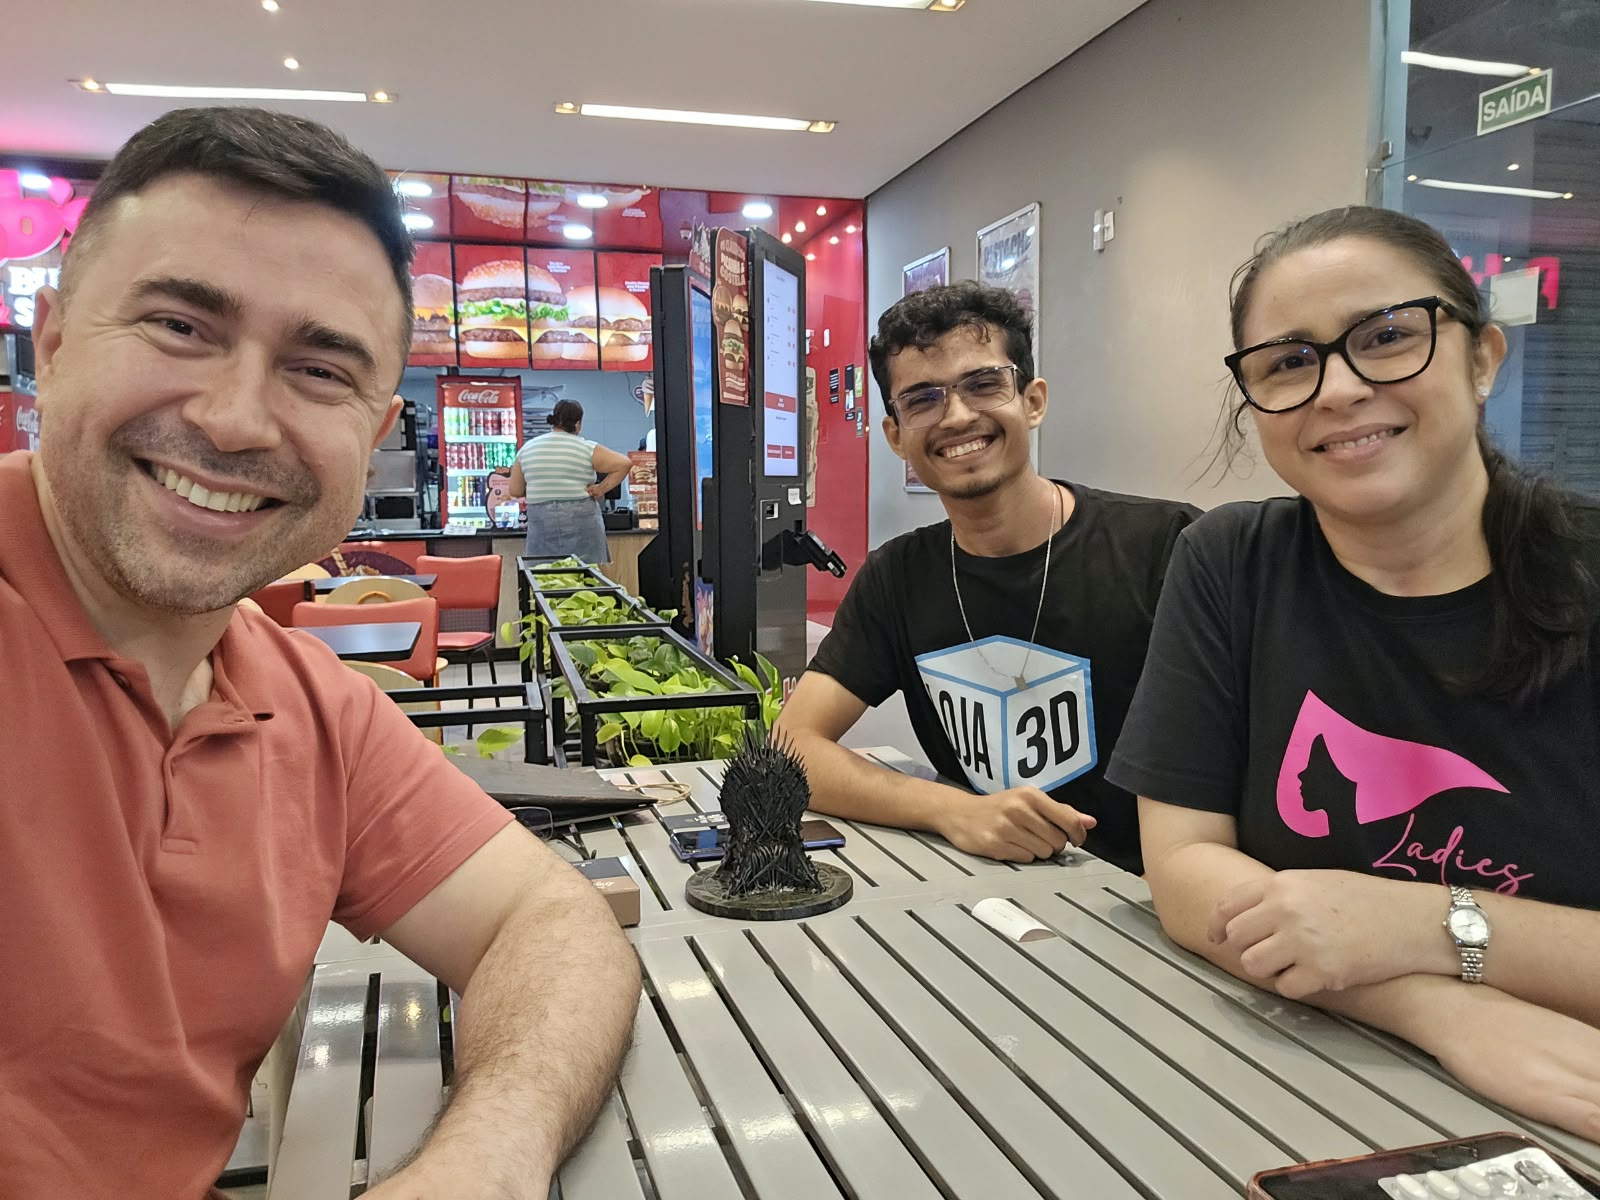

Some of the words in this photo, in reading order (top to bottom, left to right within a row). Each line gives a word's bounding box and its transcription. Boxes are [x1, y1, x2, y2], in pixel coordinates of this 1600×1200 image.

[1483, 85, 1545, 122] SAÍDA
[925, 683, 994, 781] OJA
[1015, 690, 1081, 779] 3D
[1372, 812, 1535, 897] Ladies
